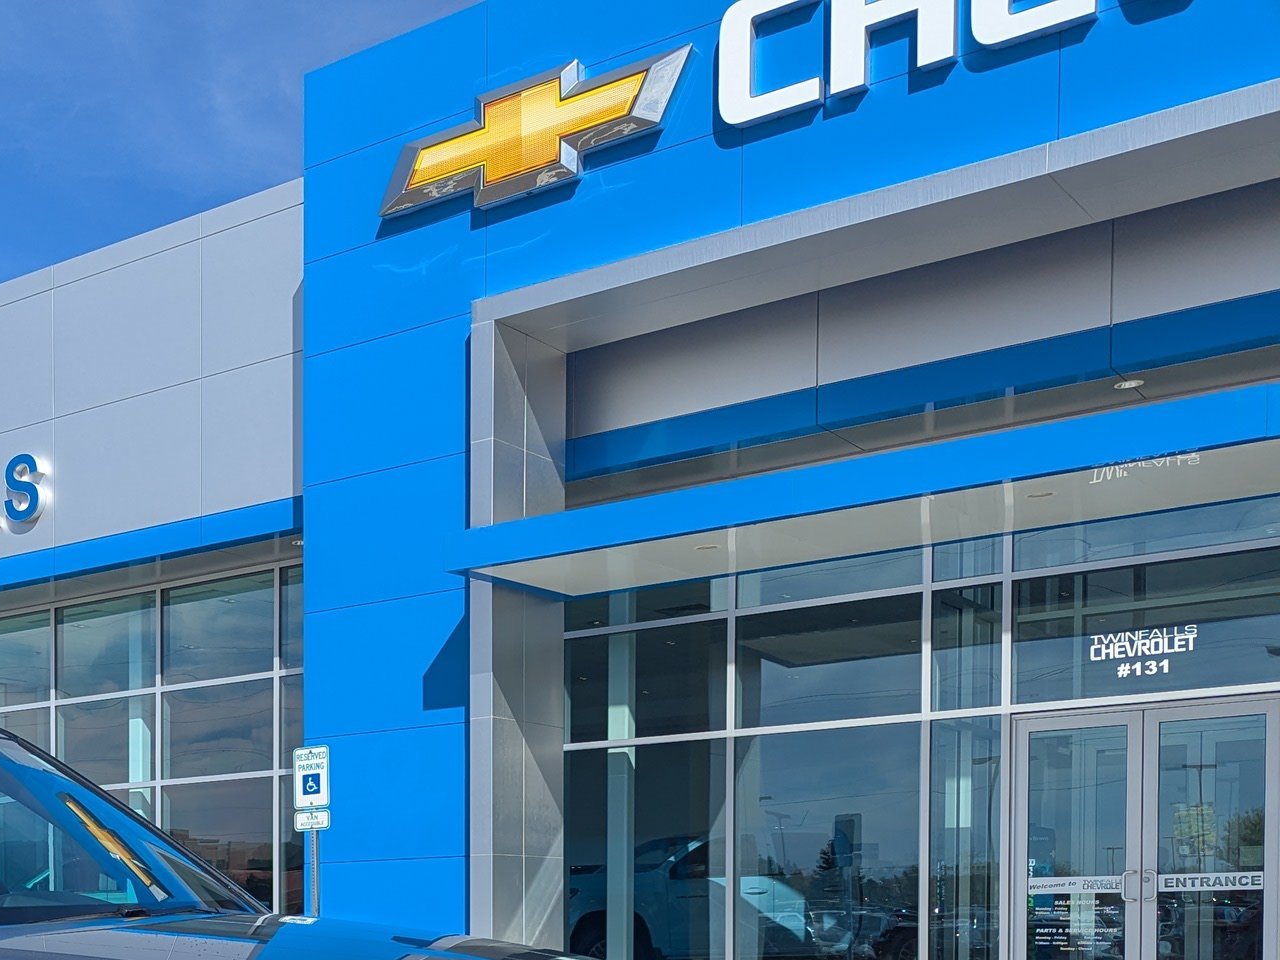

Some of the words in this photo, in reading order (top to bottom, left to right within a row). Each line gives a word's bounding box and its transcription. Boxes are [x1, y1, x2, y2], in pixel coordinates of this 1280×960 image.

[1090, 624, 1198, 645] TWINFALLS
[1090, 633, 1198, 661] CHEVROLET
[1117, 659, 1169, 678] #131
[296, 751, 326, 761] RESERVED
[297, 762, 325, 772] PARKING
[1082, 882, 1122, 890] CHEVROLE
[1164, 875, 1262, 888] ENTRANCE
